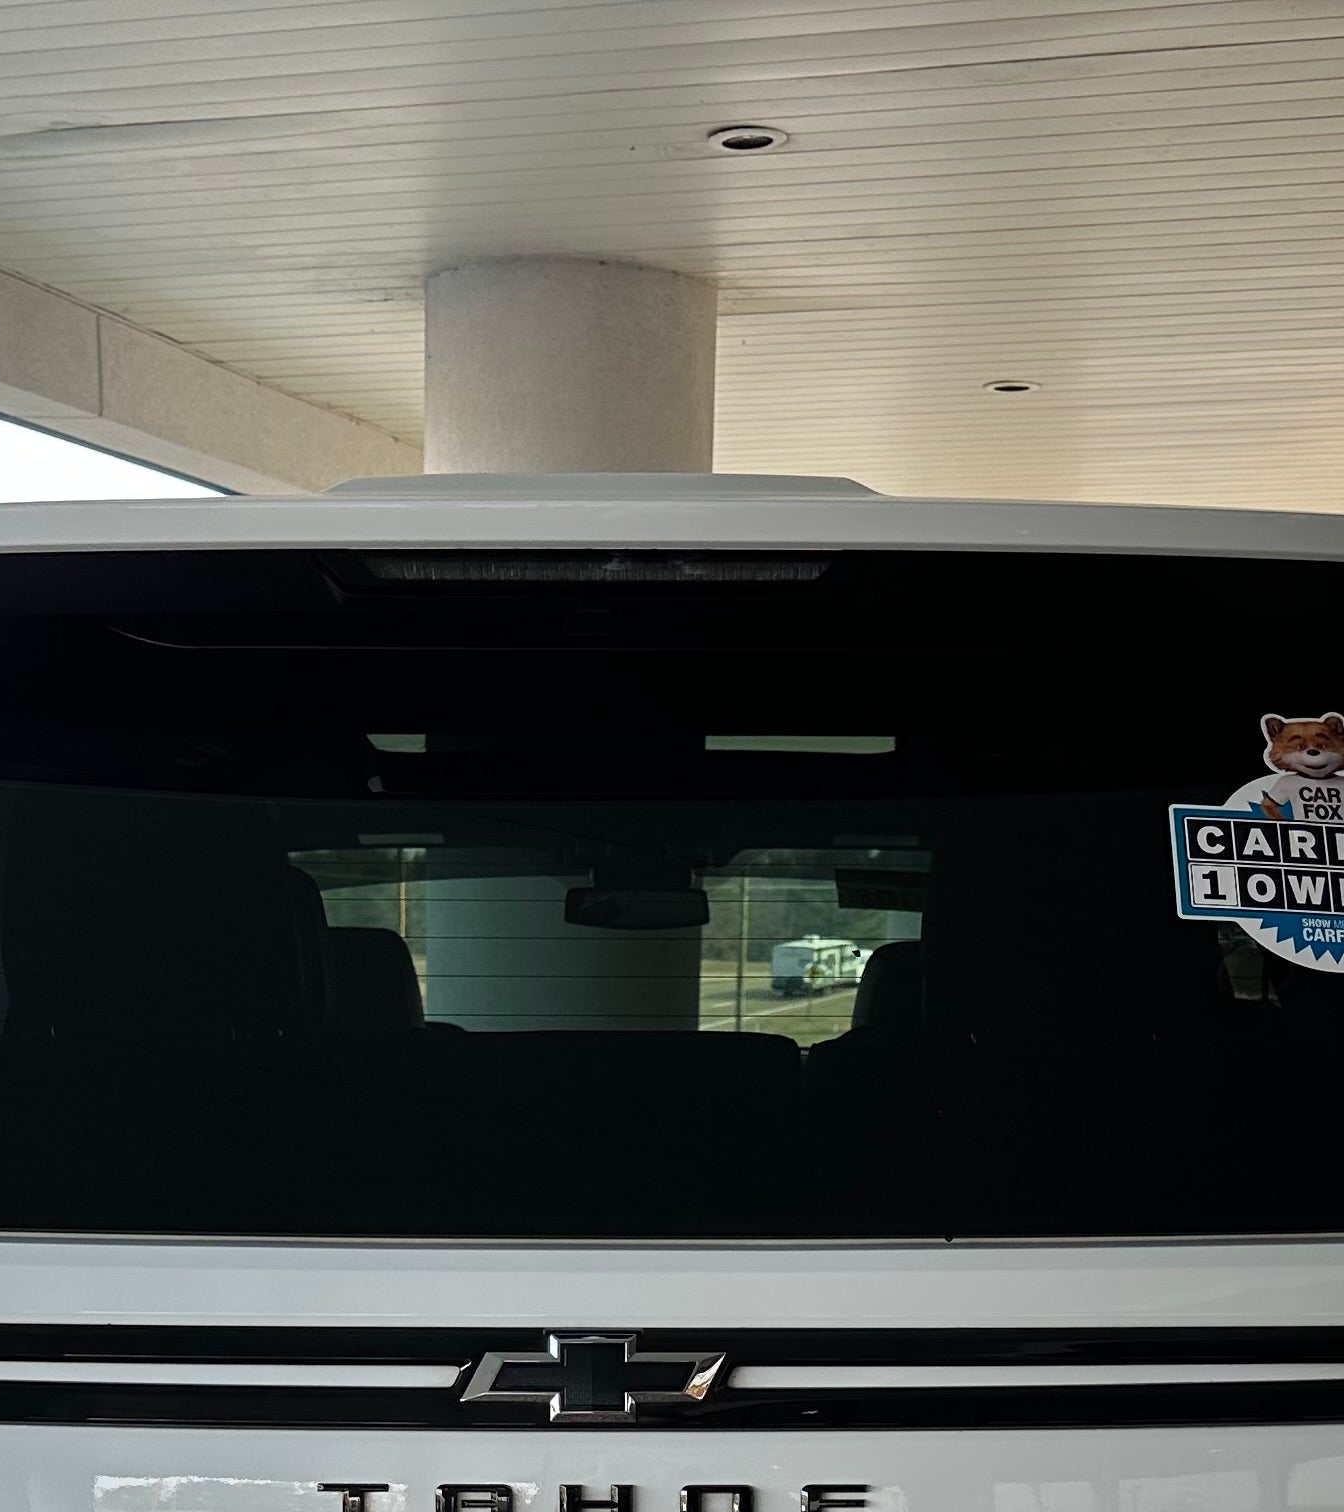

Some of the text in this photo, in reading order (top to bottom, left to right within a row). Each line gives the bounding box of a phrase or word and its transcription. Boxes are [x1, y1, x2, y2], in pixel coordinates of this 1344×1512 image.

[1299, 786, 1341, 803] CAR
[1303, 803, 1343, 820] FOX
[1301, 917, 1331, 928] SHOW
